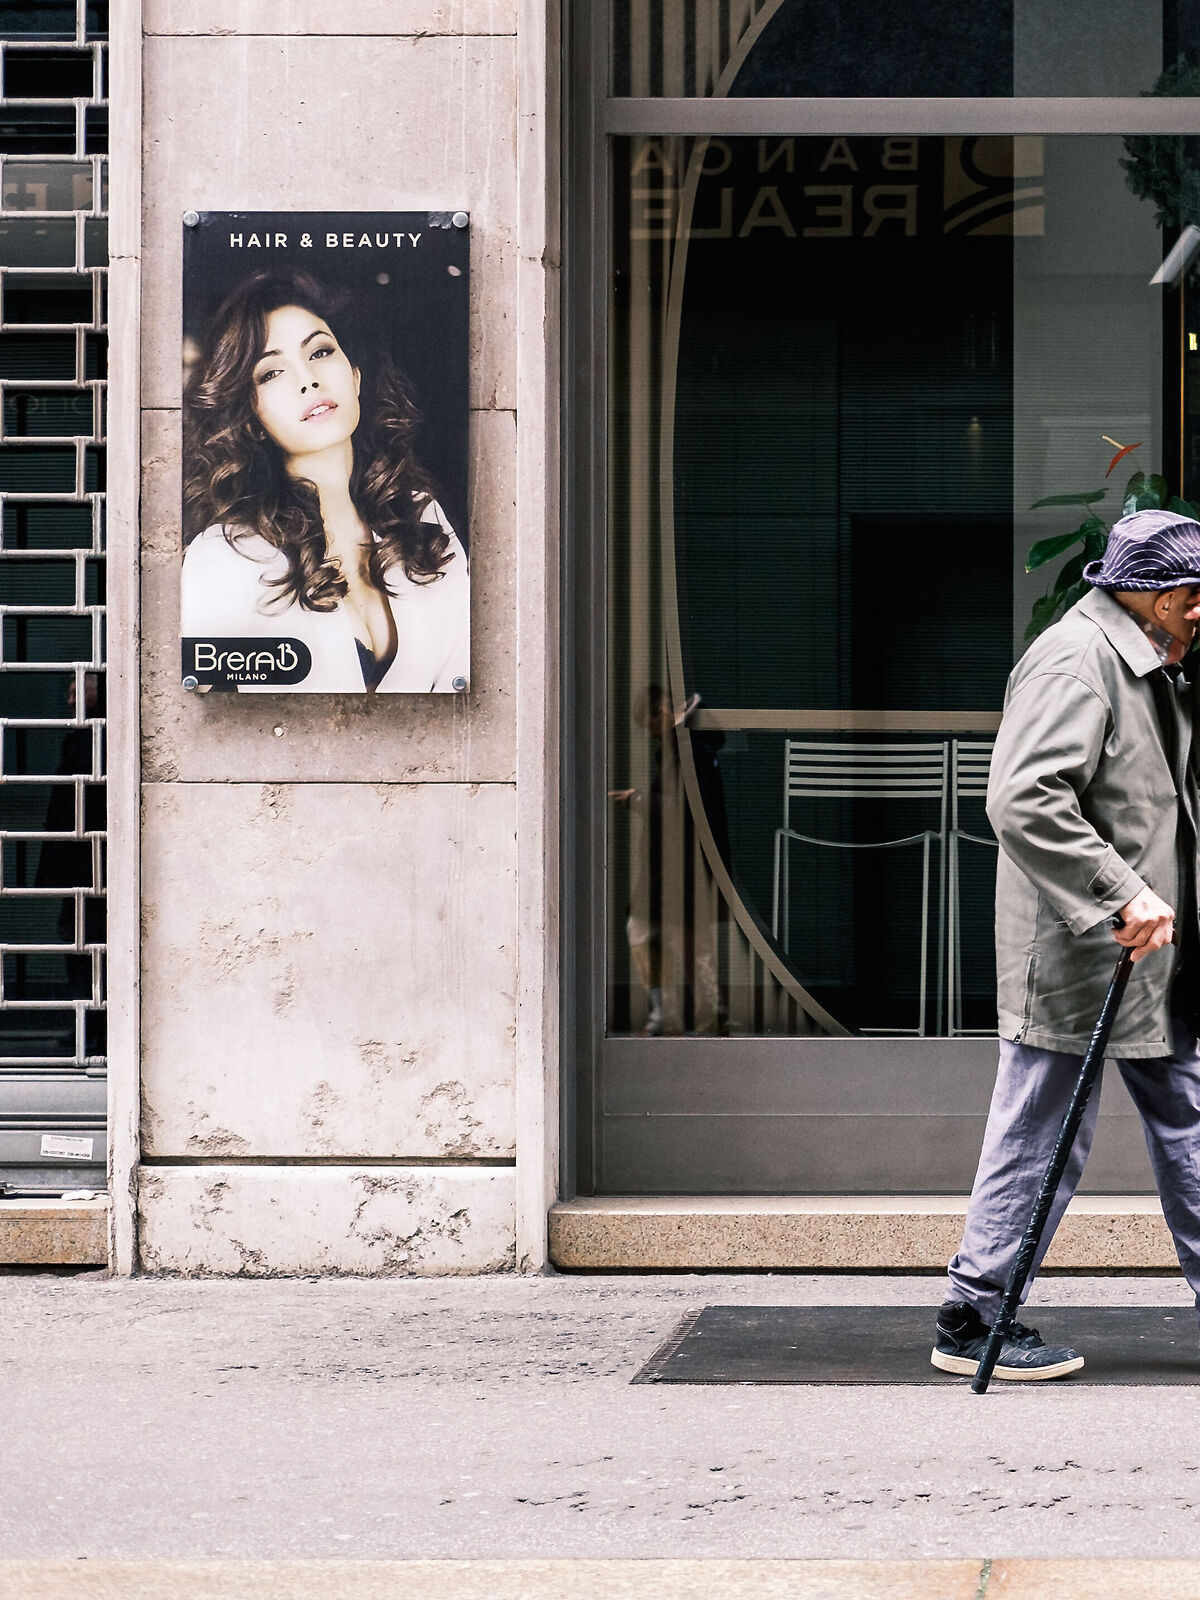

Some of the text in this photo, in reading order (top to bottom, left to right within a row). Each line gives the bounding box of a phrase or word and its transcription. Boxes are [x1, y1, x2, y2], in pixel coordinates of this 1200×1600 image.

[229, 232, 424, 248] HAIR & BEAUTY
[226, 673, 268, 681] MILANO
